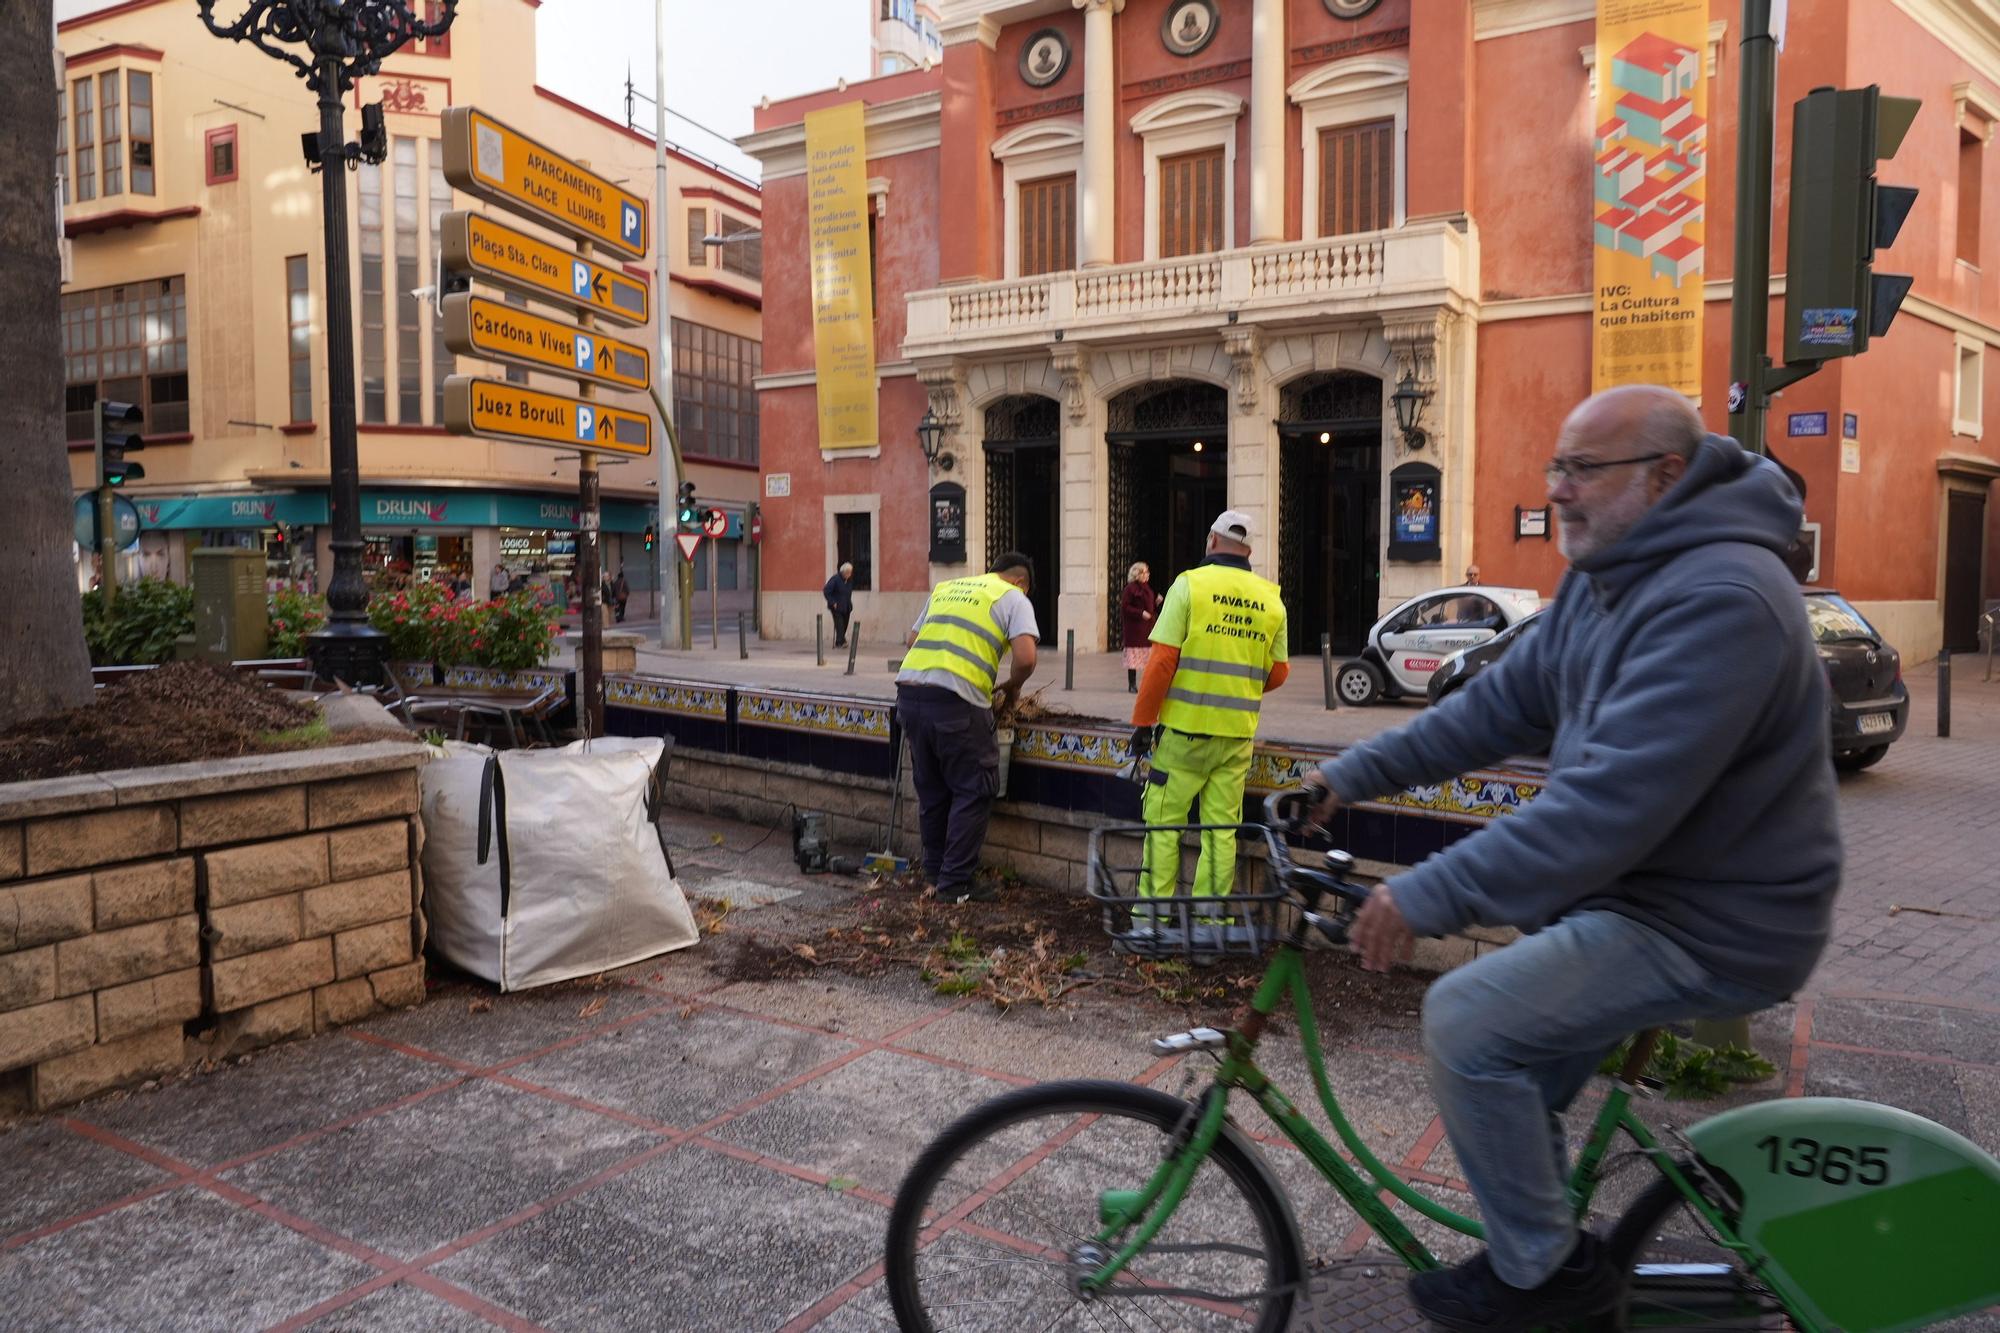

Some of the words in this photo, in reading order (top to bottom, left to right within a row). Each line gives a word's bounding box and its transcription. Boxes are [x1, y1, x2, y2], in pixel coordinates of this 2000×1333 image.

[829, 144, 855, 159] pobles
[527, 152, 602, 203] APARCAMENTS
[817, 175, 835, 185] cada
[813, 190, 825, 199] dia
[523, 177, 558, 207] PLACE
[567, 198, 606, 229] LLIURES
[814, 203, 823, 211] en
[625, 207, 638, 237] P
[814, 210, 856, 224] condicions
[815, 239, 825, 249] de
[472, 232, 504, 260] Plaça
[531, 255, 558, 278] Clara
[574, 262, 588, 294] P
[1600, 285, 1631, 298] IVC:
[818, 303, 831, 313] per
[1600, 301, 1618, 312] La
[1622, 296, 1680, 310] Cultura
[1600, 315, 1627, 328] que
[1631, 309, 1696, 324] habitem
[474, 312, 533, 345] Cardona
[540, 331, 572, 357] Vives
[577, 337, 591, 368] P
[477, 393, 512, 417] Juez
[520, 401, 565, 426] Borull
[579, 407, 592, 438] P
[232, 501, 266, 517] DRUNI
[377, 500, 431, 516] DRUNI
[540, 503, 573, 519] DRUNI
[1213, 594, 1266, 613] PAVASAL
[1222, 612, 1253, 626] ZERO
[1205, 624, 1266, 643] ACCIDENTS
[1755, 1135, 1890, 1186] 1365
